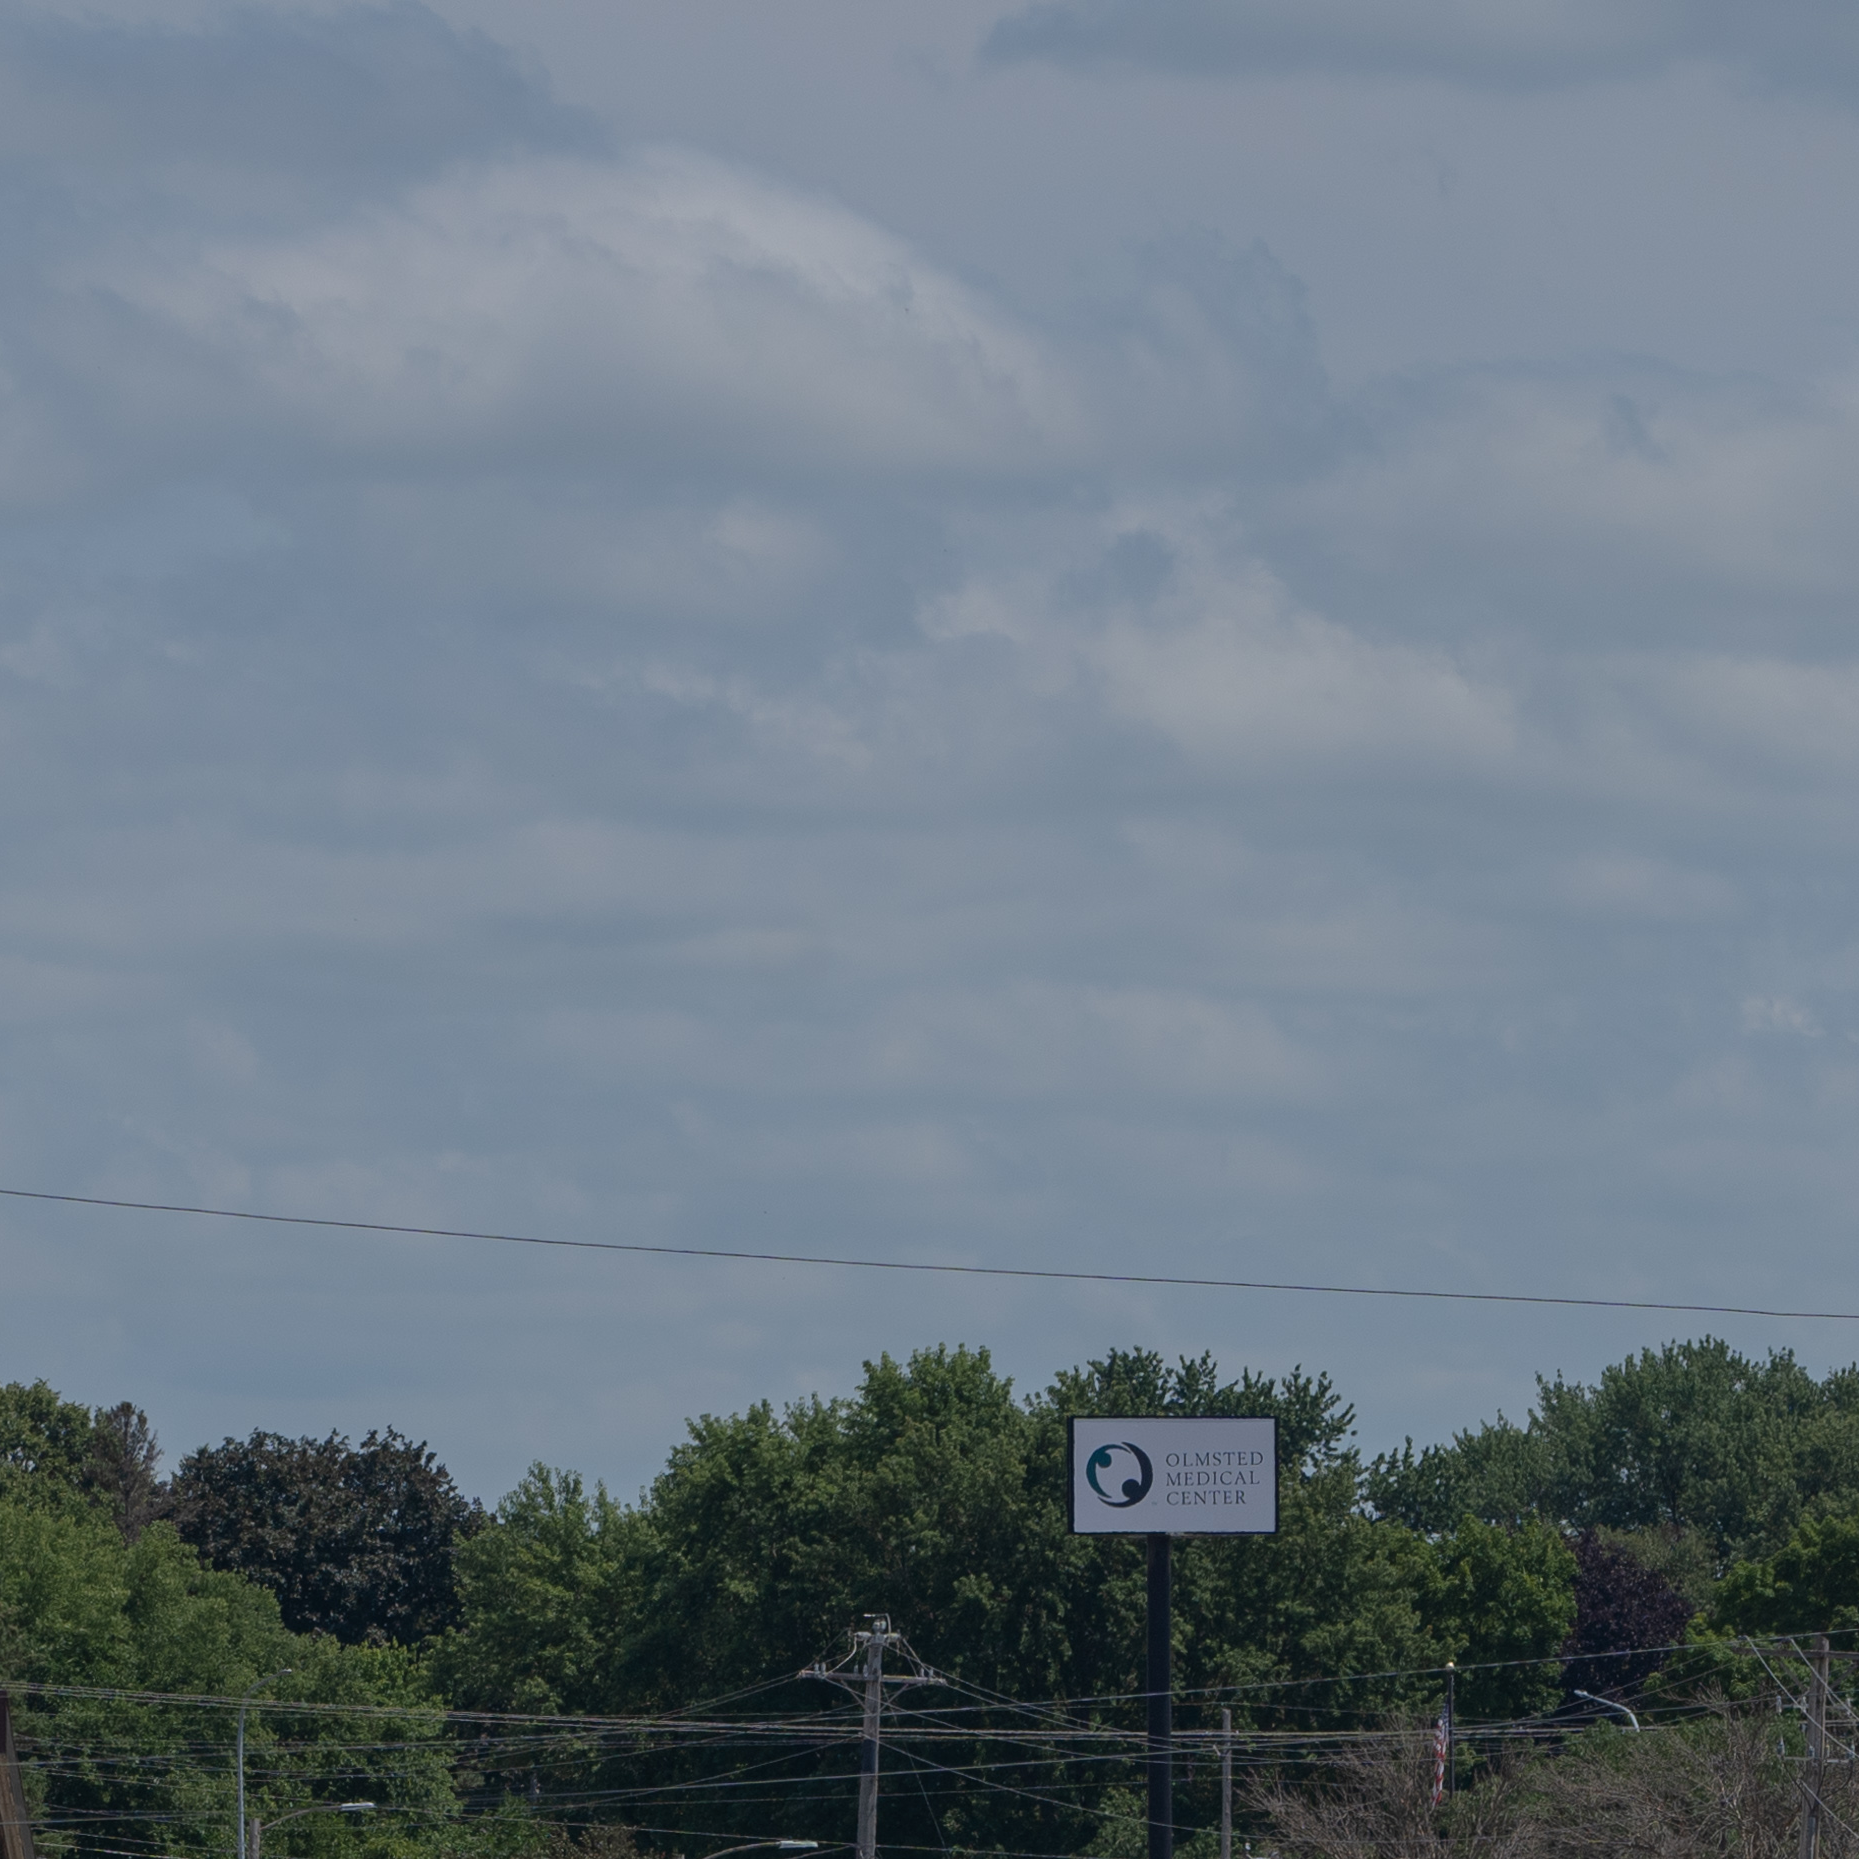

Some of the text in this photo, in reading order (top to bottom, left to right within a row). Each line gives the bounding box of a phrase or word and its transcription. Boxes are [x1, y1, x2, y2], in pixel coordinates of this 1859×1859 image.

[1166, 1450, 1264, 1468] OLMSTED
[1166, 1470, 1260, 1487] MEDICAL
[1166, 1490, 1246, 1506] CENTER
